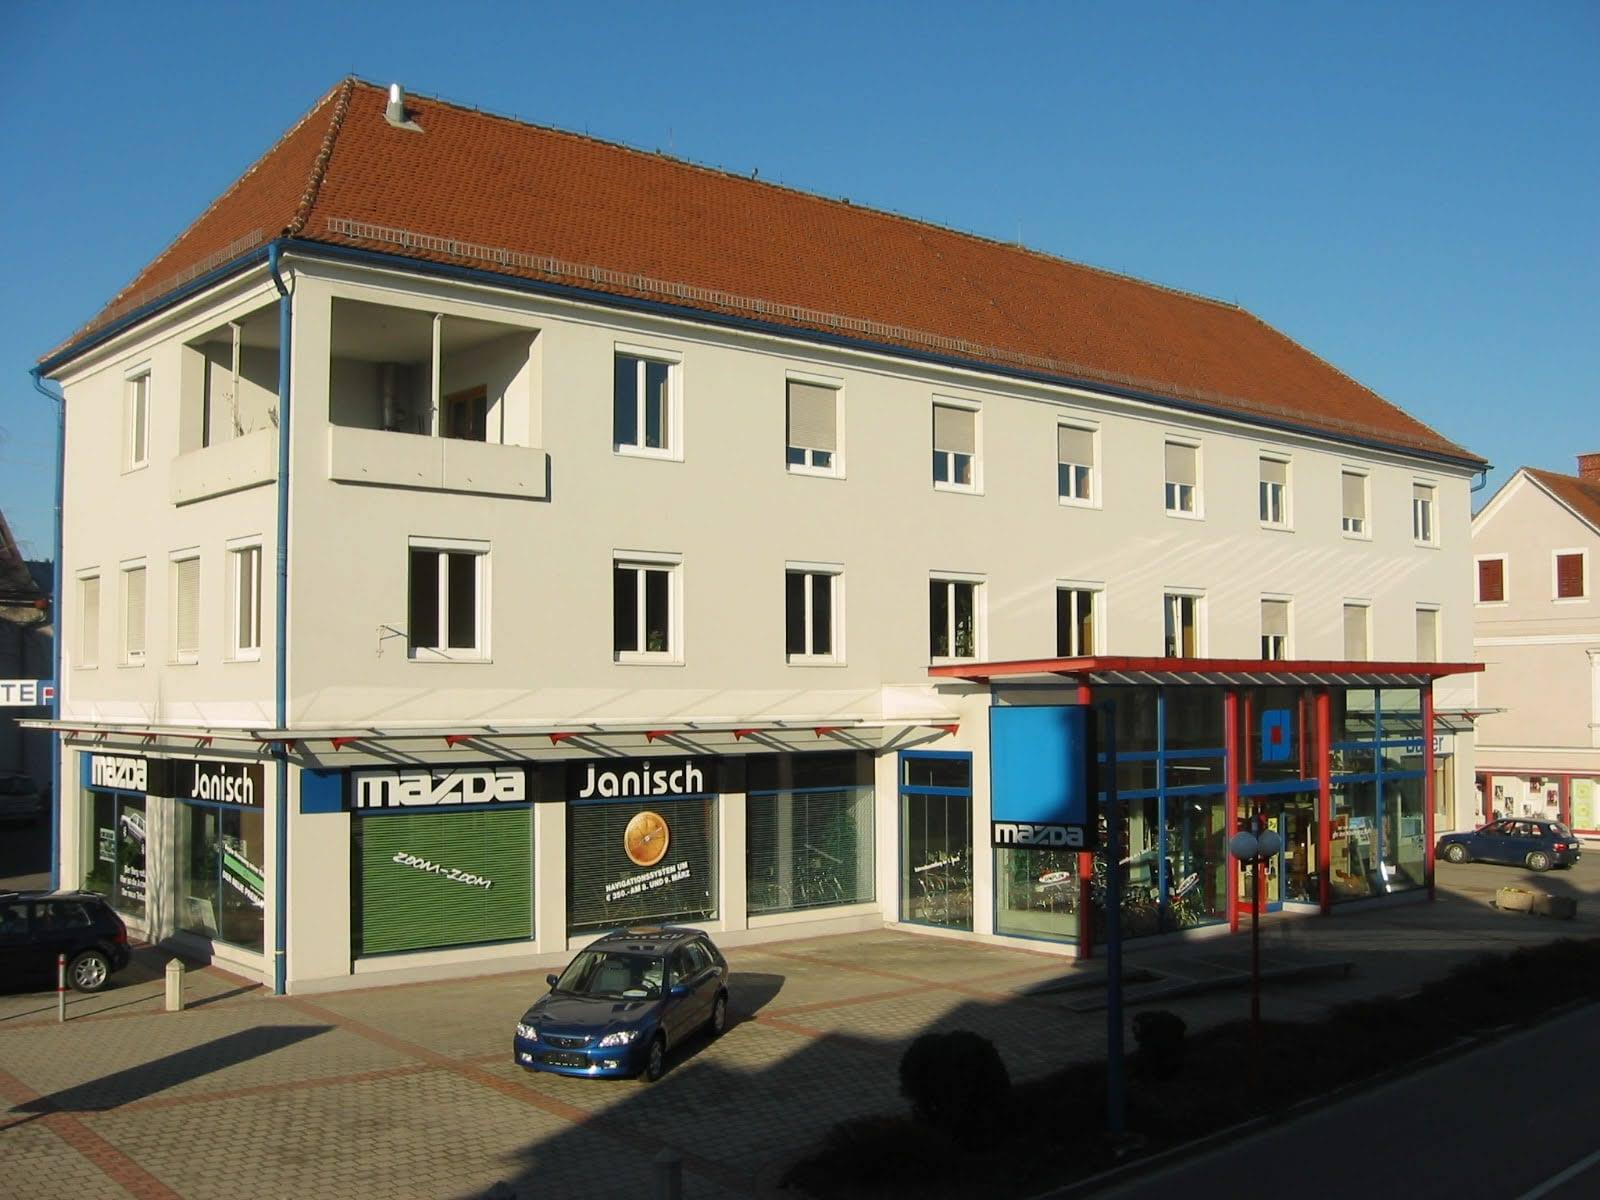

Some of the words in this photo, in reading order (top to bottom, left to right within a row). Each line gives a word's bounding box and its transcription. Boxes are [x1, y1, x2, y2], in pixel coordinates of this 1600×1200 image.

[191, 763, 254, 804] Janisch
[579, 760, 703, 798] Janisch
[605, 864, 677, 892] NAVIGATIONSSYSTEM
[676, 861, 689, 871] UM
[649, 879, 664, 888] UND
[671, 870, 691, 882] MÄRZ
